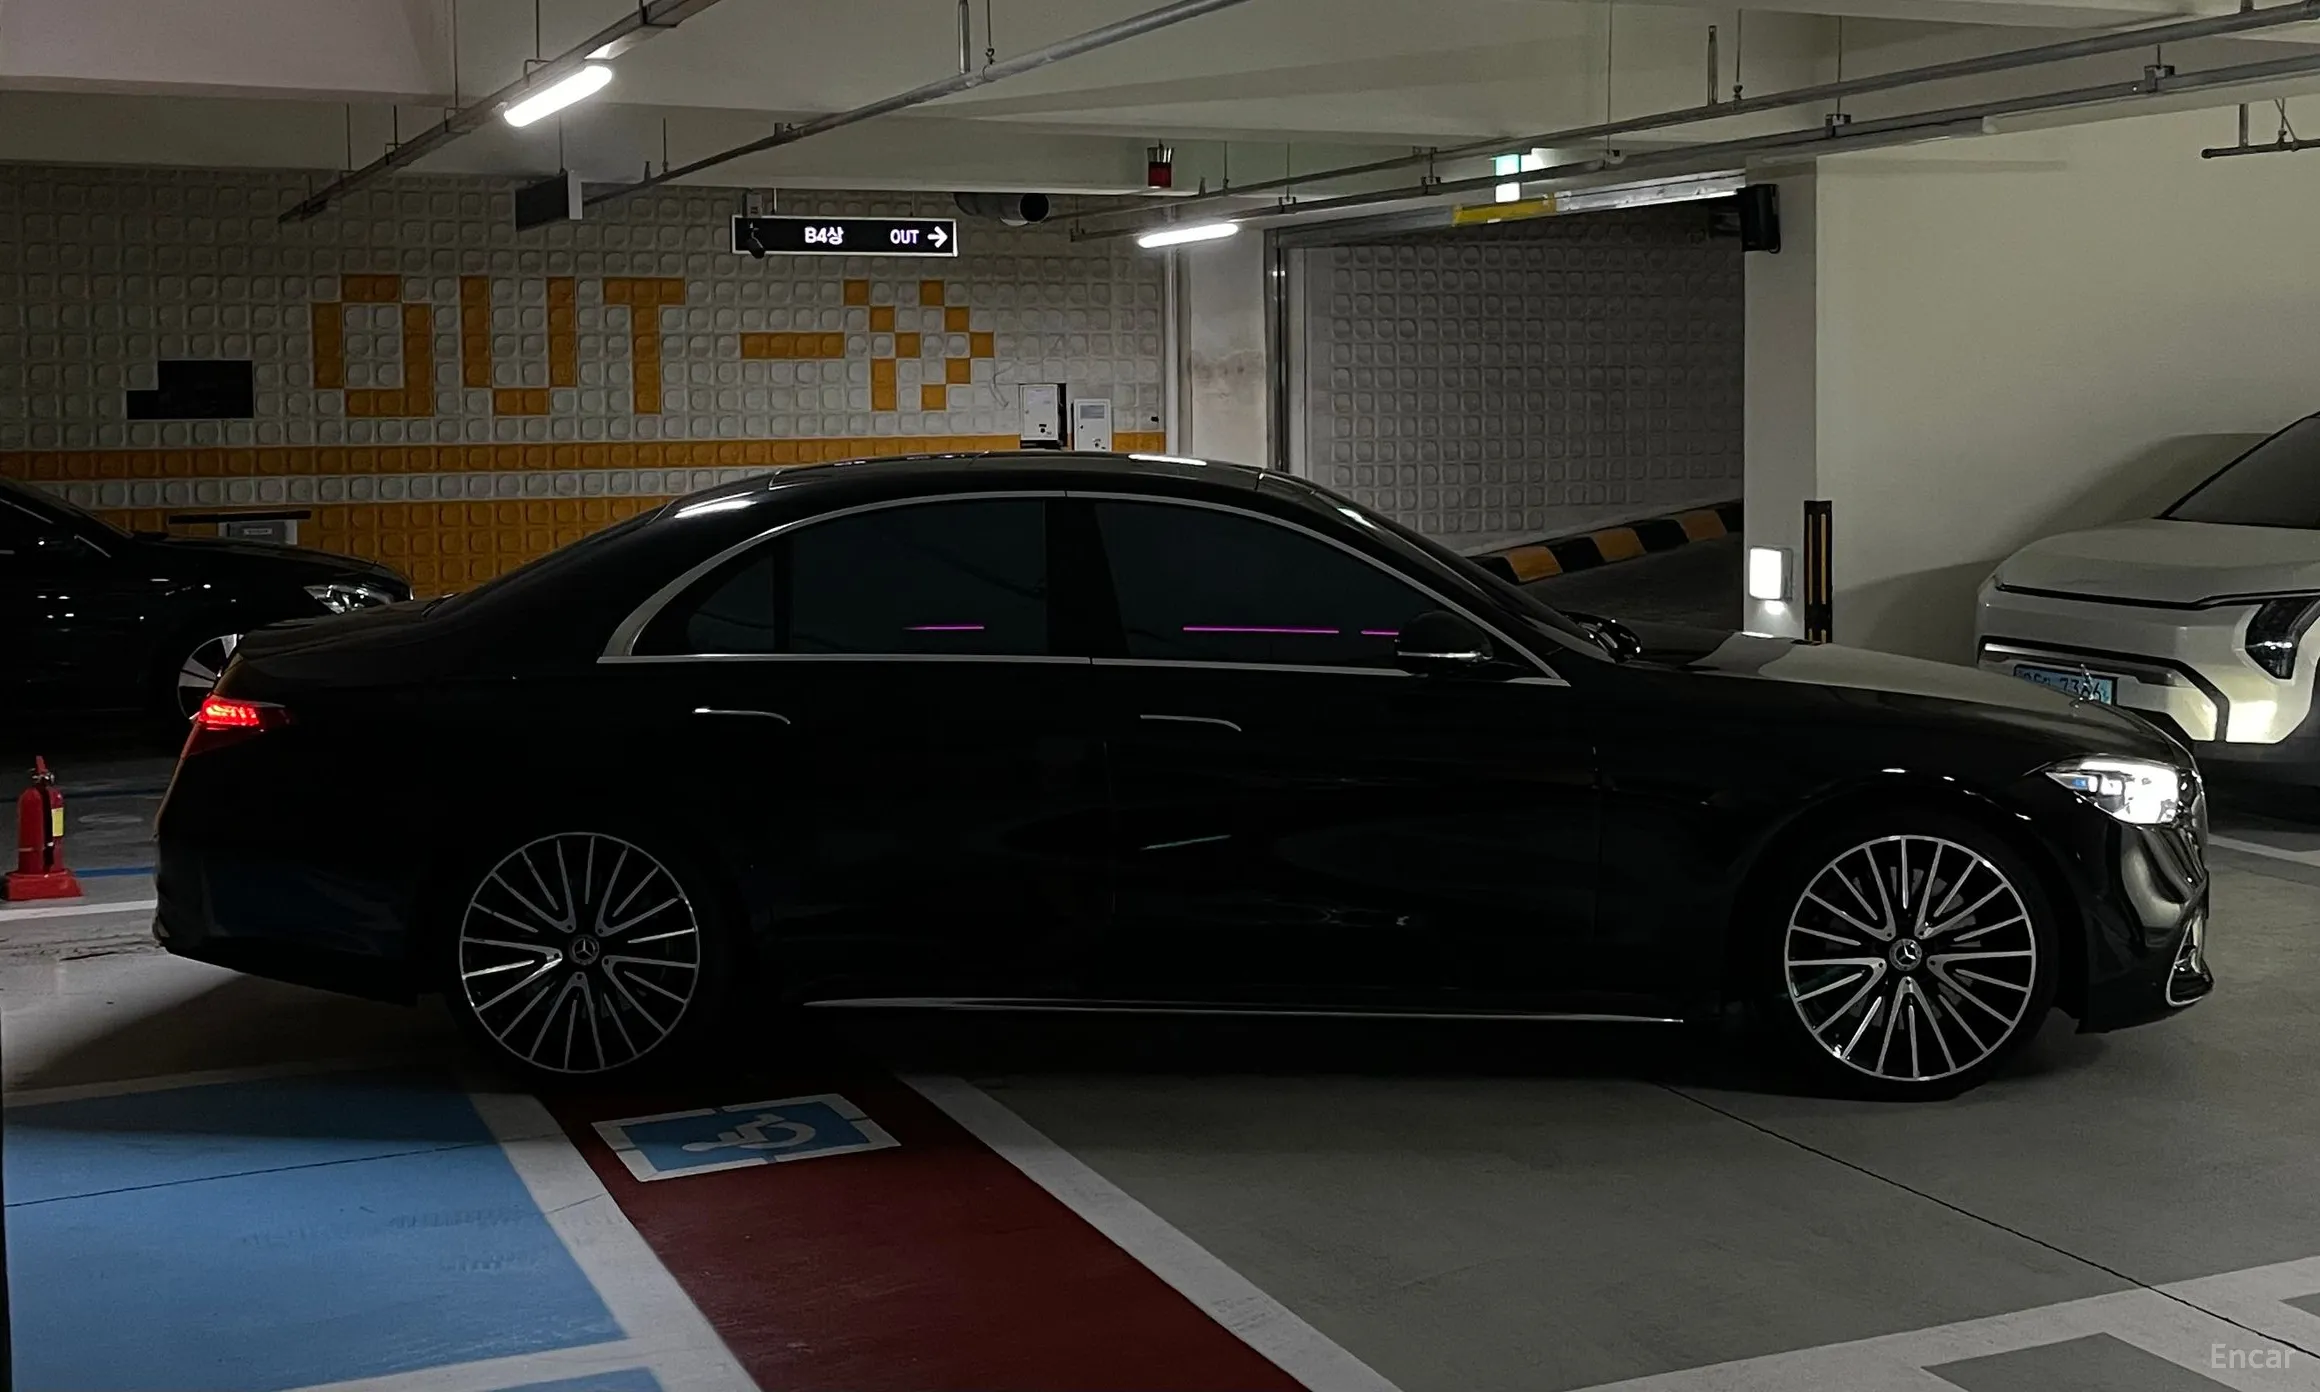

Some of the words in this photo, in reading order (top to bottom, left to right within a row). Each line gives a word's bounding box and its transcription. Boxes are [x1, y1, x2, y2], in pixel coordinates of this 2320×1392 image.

[803, 226, 844, 245] B4상
[889, 229, 920, 245] OUT
[312, 274, 685, 417] OUT
